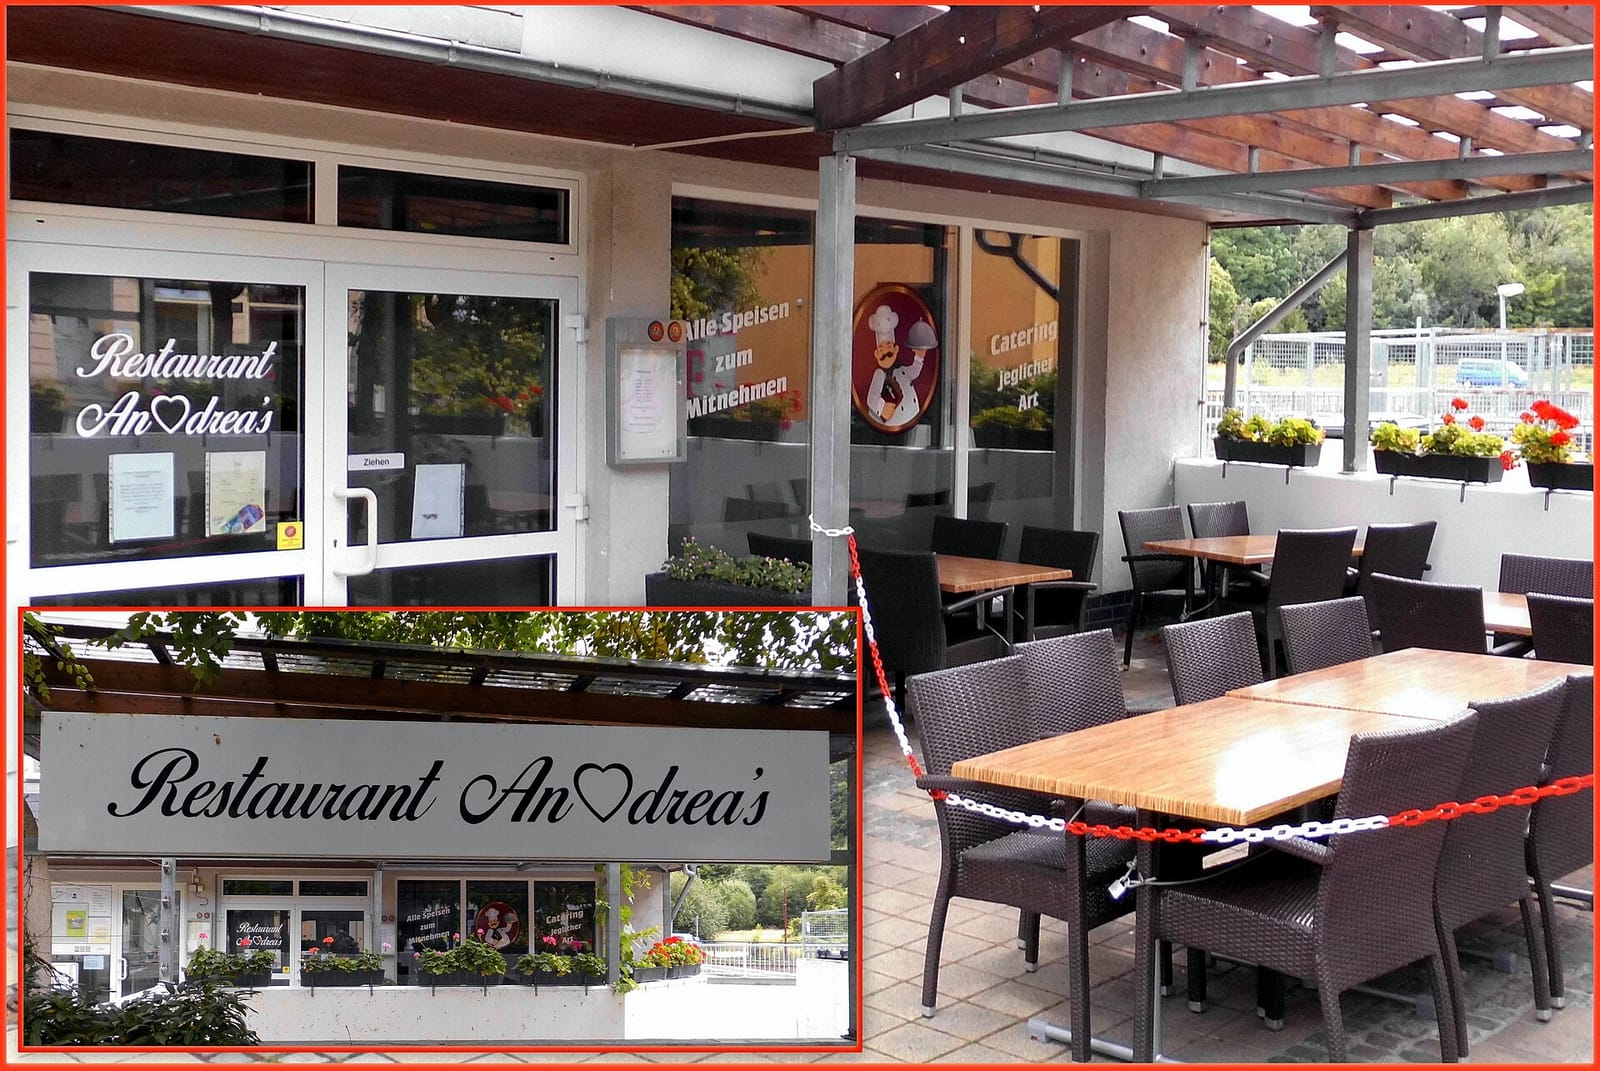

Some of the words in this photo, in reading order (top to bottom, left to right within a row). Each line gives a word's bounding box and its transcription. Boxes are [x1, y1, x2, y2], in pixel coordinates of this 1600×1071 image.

[687, 317, 718, 342] Alle
[721, 301, 790, 334] Speisen
[991, 320, 1057, 356] Catering
[76, 333, 278, 379] Restaurant
[715, 348, 753, 373] zum
[997, 357, 1054, 391] jeglicher
[686, 376, 787, 420] Mitnehmen
[1018, 391, 1039, 412] Art
[363, 458, 390, 466] Ziehen
[107, 747, 444, 821] Restaurant
[406, 914, 421, 922] Alle
[422, 908, 451, 919] Speisen
[420, 922, 436, 931] zum
[236, 921, 284, 933] Restaurant
[550, 923, 582, 936] jeglicher
[561, 936, 574, 945] Art
